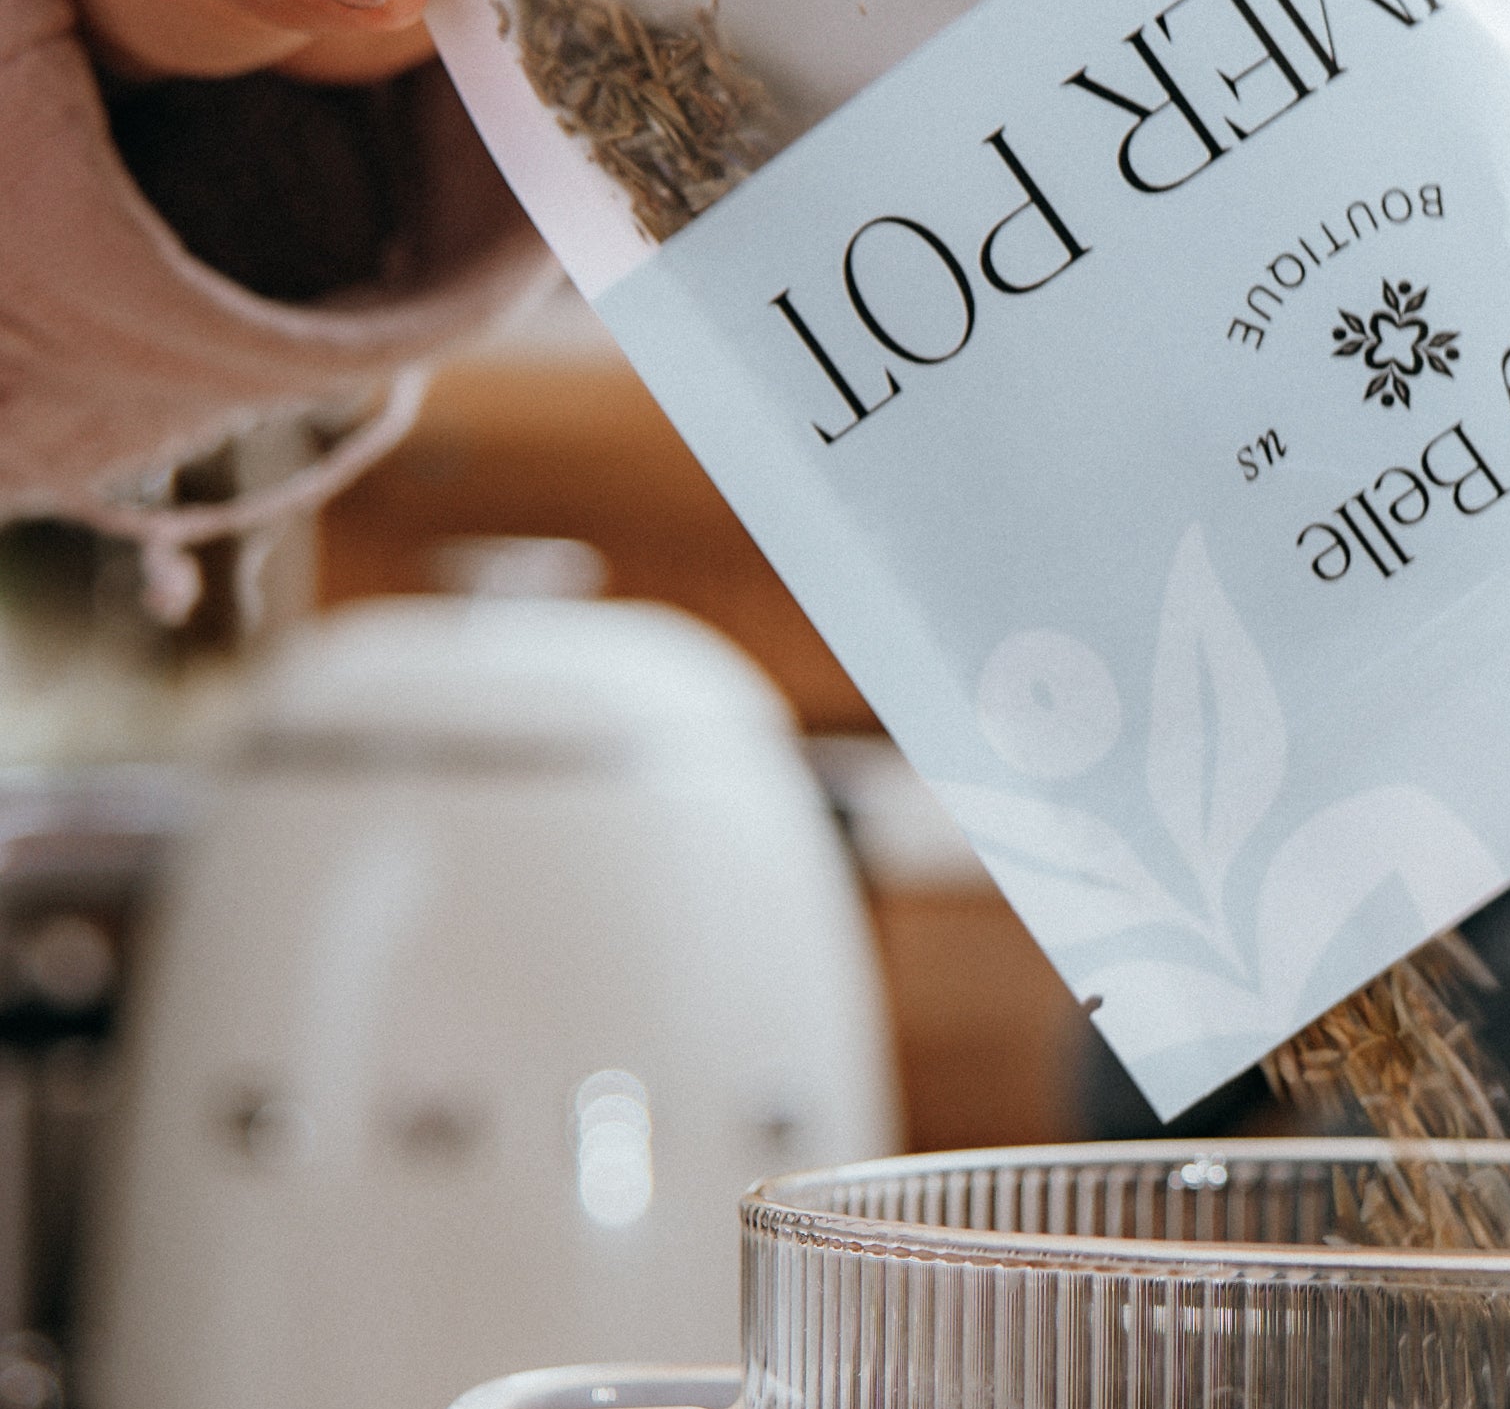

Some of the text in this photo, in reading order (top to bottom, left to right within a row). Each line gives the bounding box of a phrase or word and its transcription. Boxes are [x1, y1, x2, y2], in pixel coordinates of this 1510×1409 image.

[769, 125, 1093, 447] POT
[1226, 183, 1445, 352] BOUTIQUE
[1237, 427, 1288, 483] us
[1295, 421, 1510, 583] Belle
